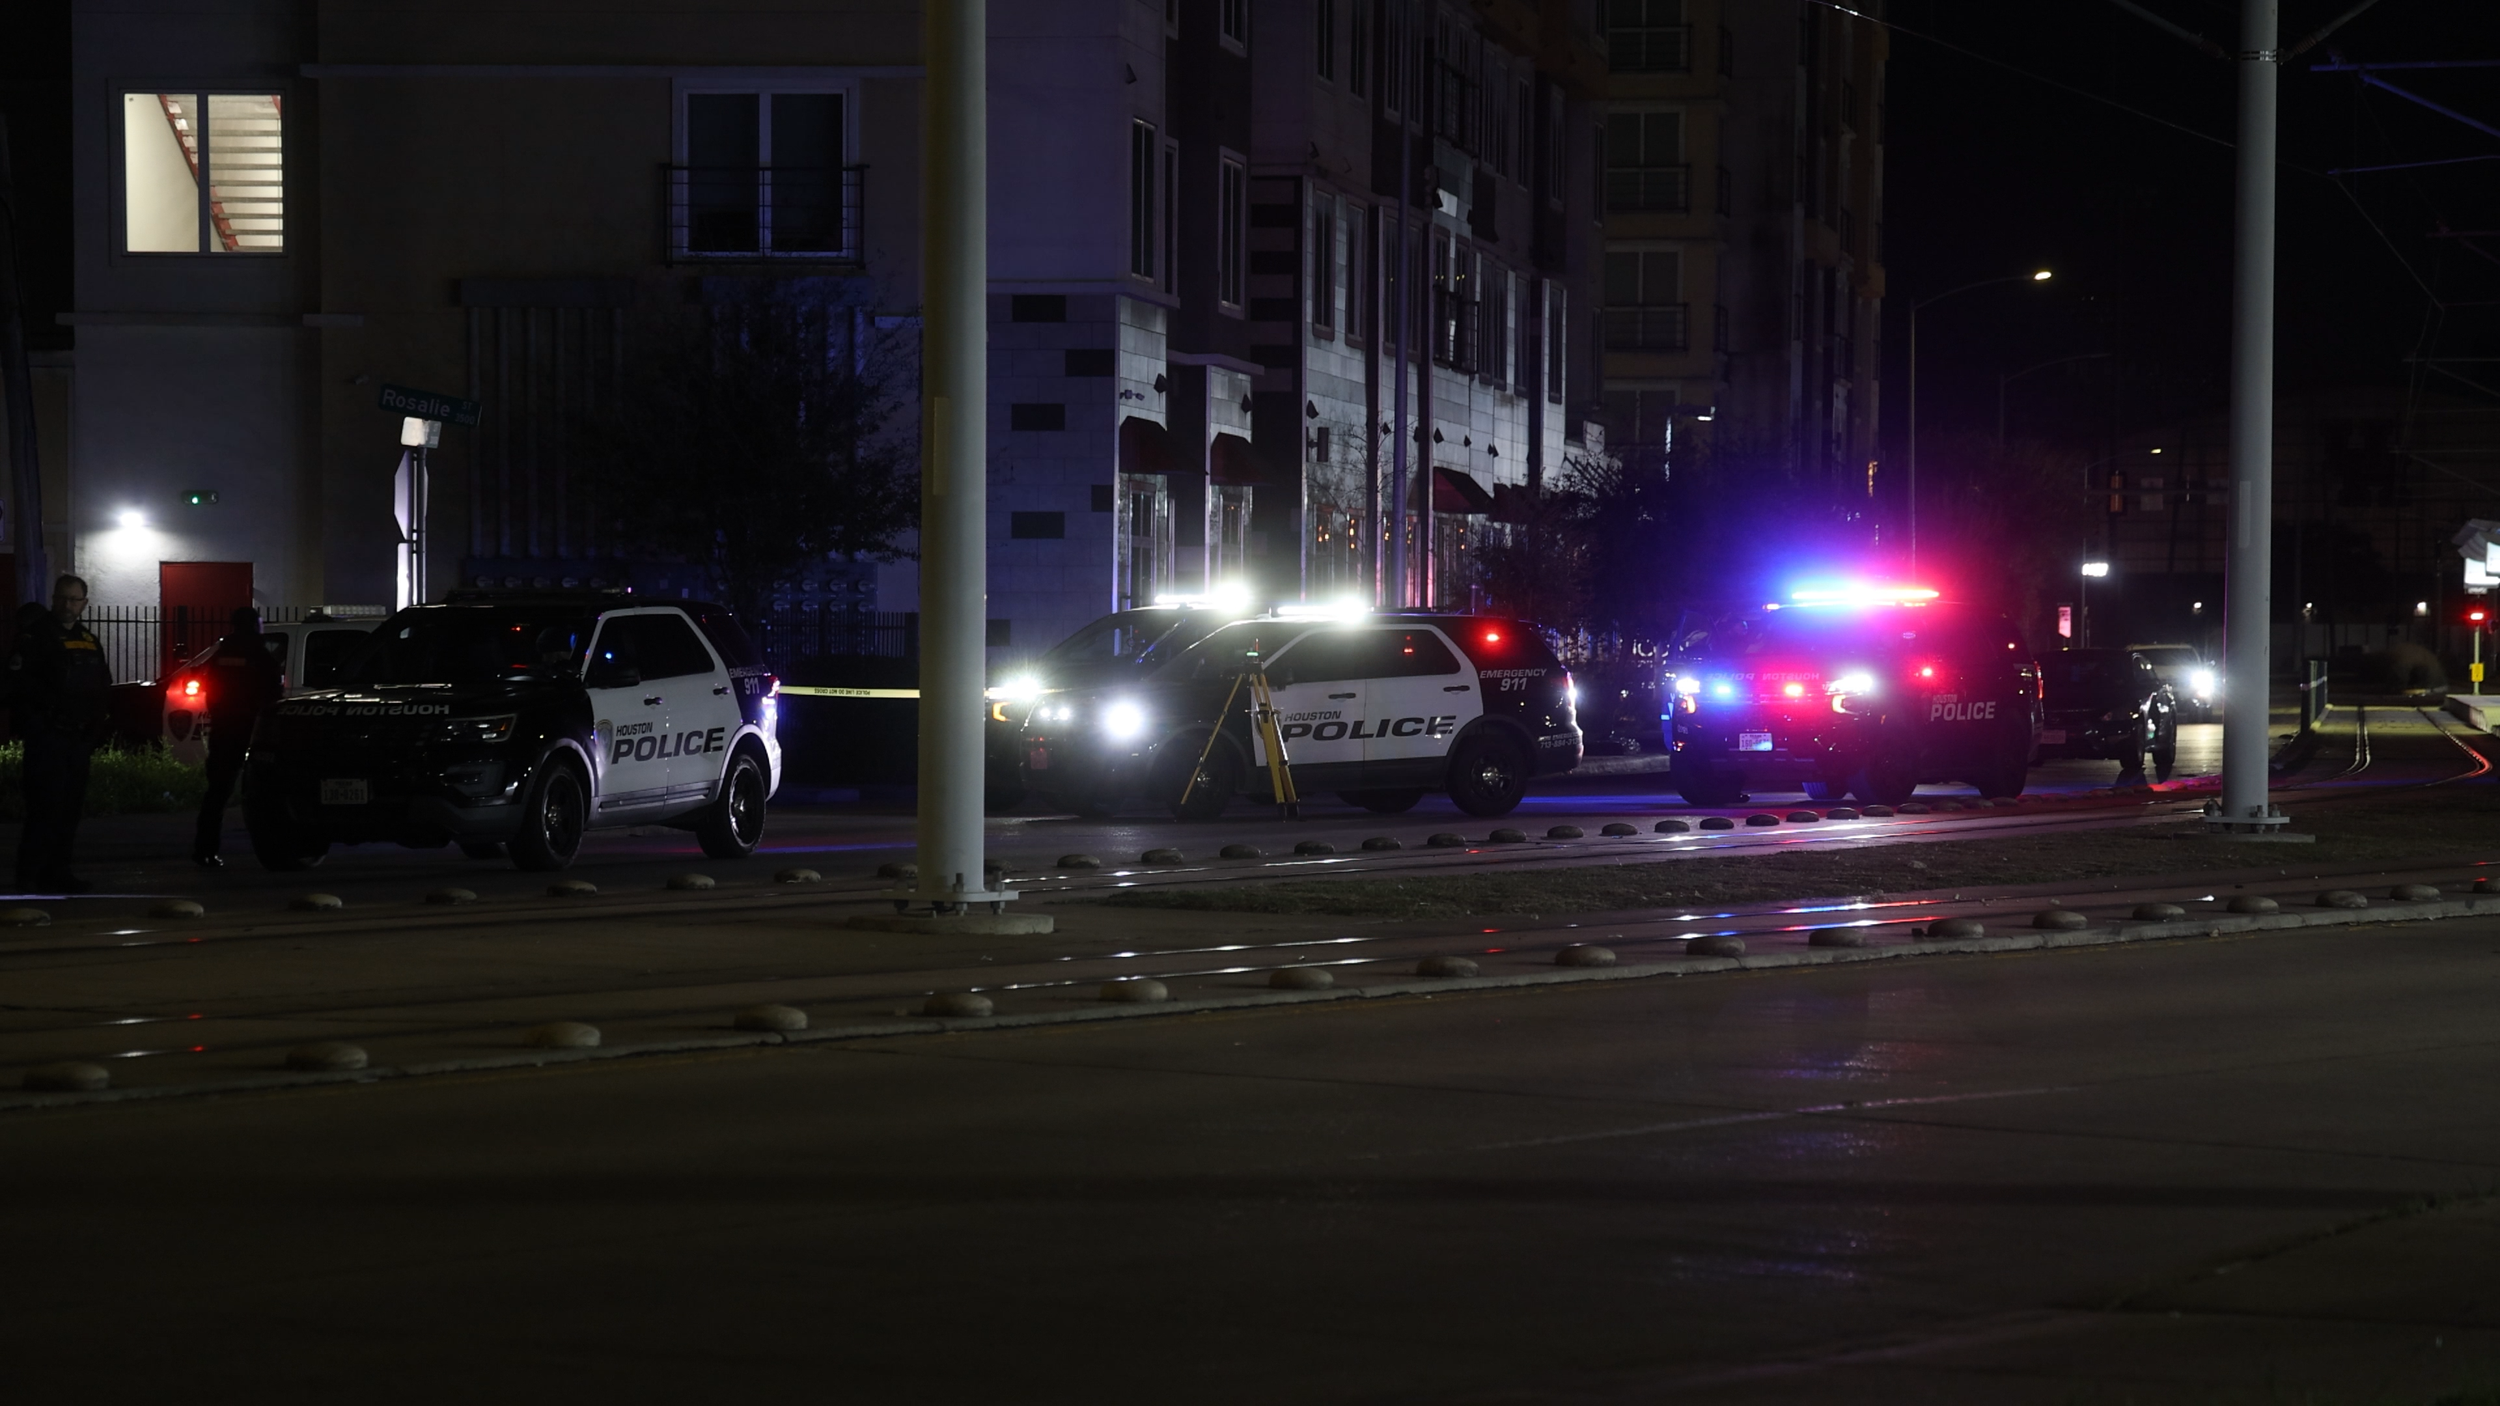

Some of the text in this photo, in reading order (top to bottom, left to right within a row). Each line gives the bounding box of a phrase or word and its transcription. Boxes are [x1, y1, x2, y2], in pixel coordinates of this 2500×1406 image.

[382, 388, 451, 417] Rosalie
[461, 401, 473, 410] ST
[1480, 668, 1547, 679] EMERGENCY
[744, 677, 760, 695] 911
[1500, 677, 1527, 691] 911
[1285, 711, 1342, 722] HOUSTON
[1930, 701, 1996, 722] POLICE
[616, 722, 653, 737] HOUSTON
[1282, 715, 1456, 743] POLICE
[611, 727, 725, 764] POLICE
